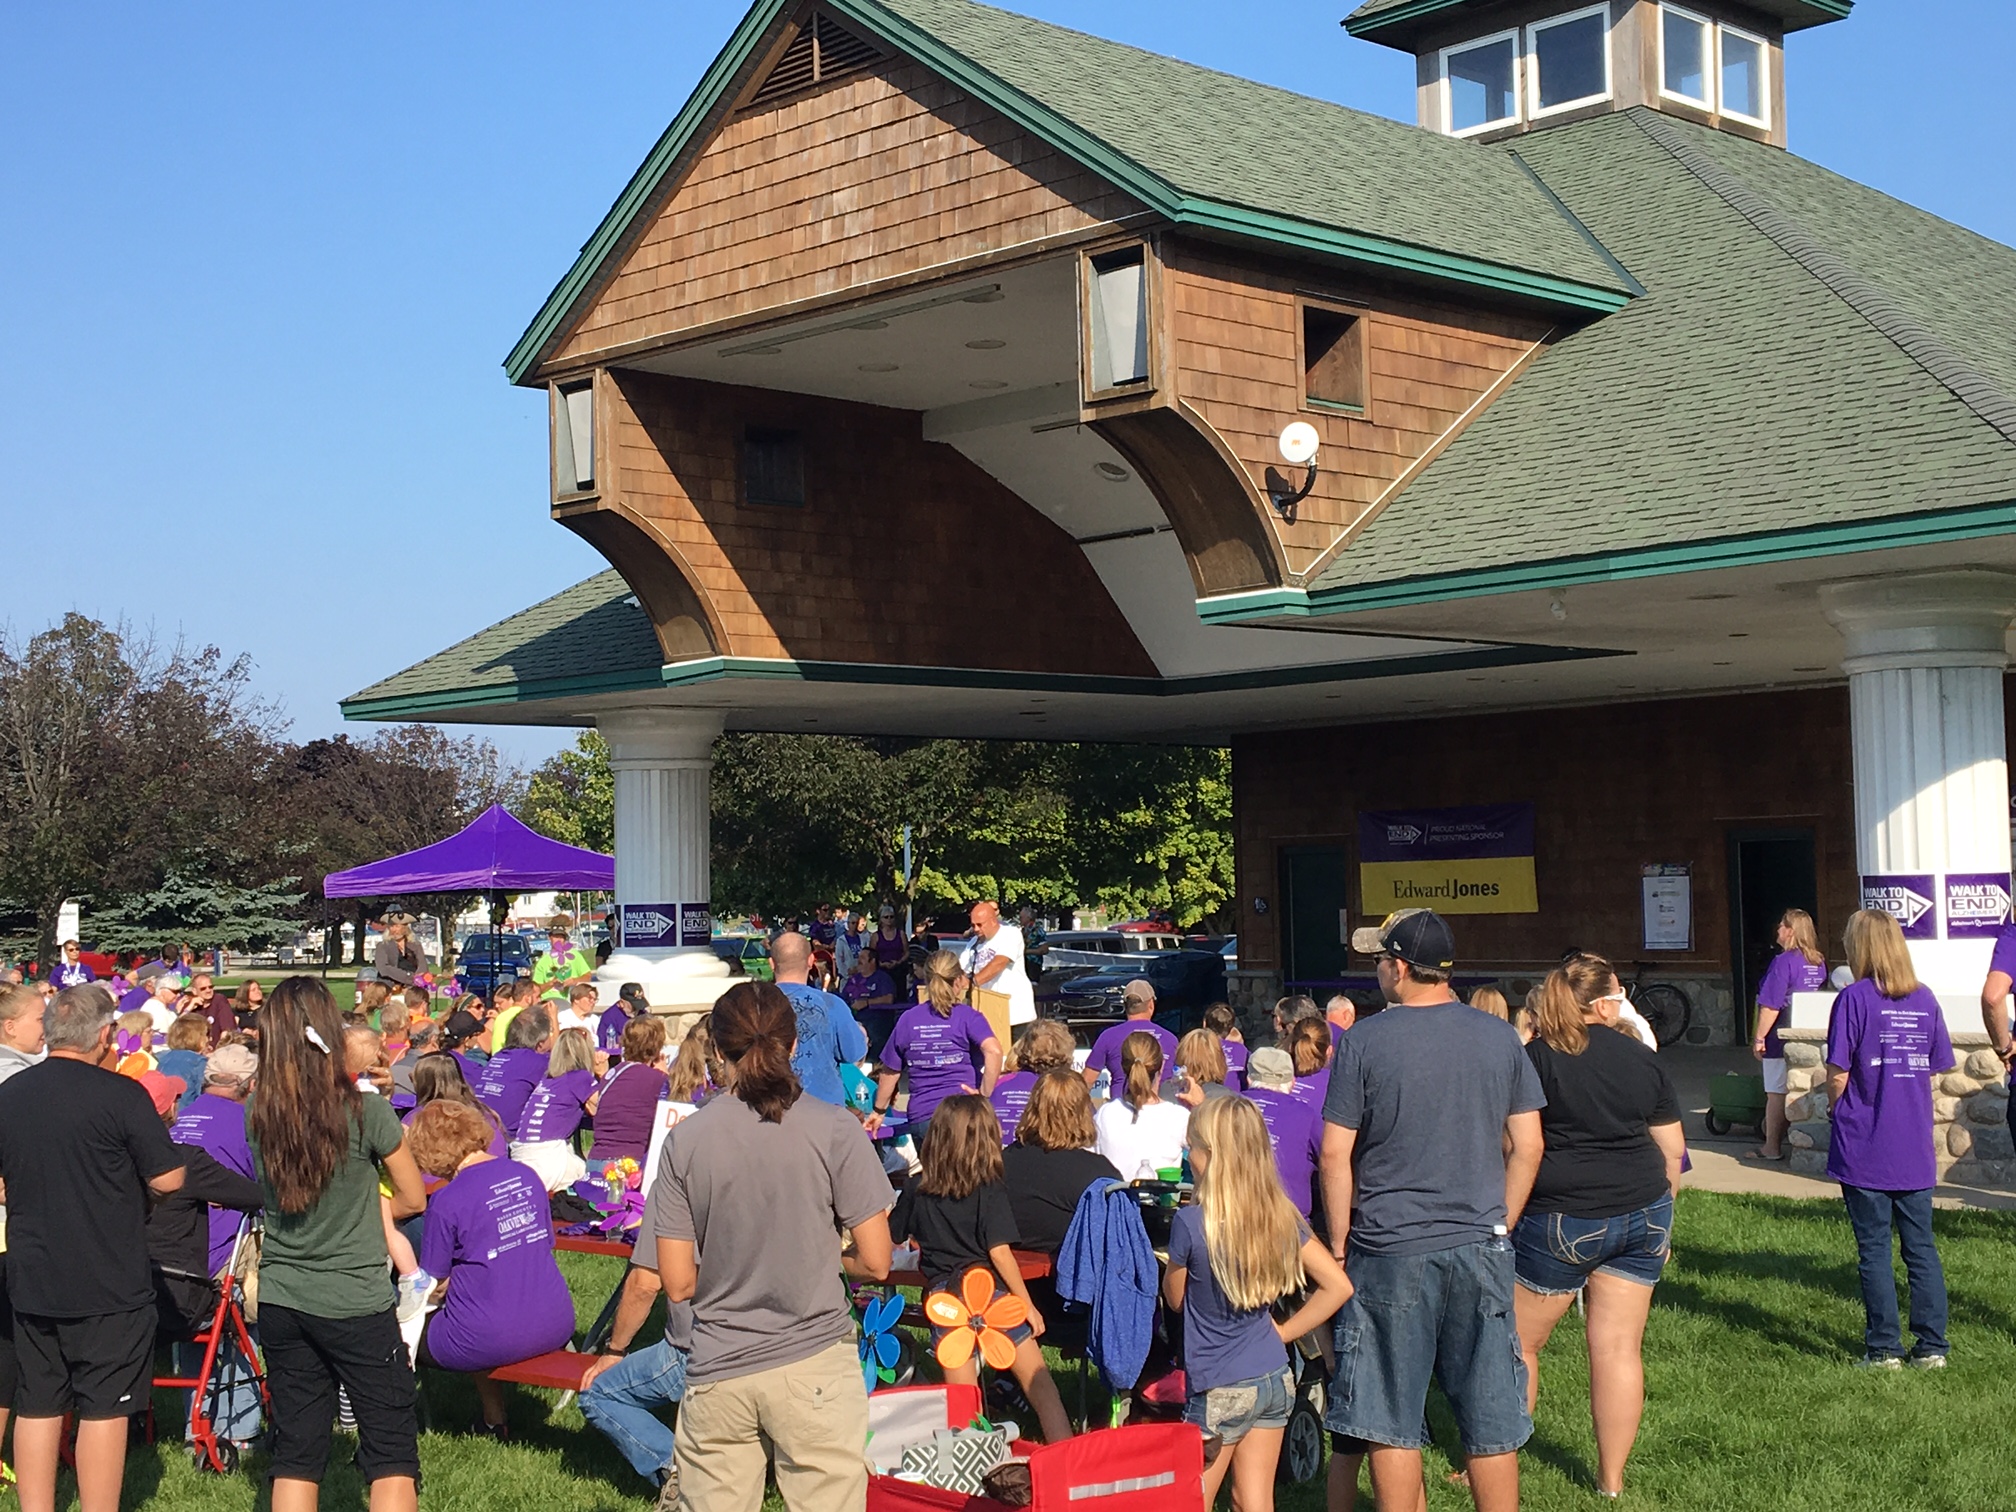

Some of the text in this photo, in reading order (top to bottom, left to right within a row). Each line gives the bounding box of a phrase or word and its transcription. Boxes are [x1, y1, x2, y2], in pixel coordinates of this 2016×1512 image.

[1431, 824, 1487, 833] PROUD NATIONAL
[1429, 831, 1505, 842] PRESENTING SPONSOR
[1864, 886, 1903, 898] WALK TO
[1949, 884, 1997, 896] WALK TO
[1865, 900, 1904, 911] END
[1951, 898, 1997, 910] END
[625, 911, 656, 919] WALK TO
[626, 920, 656, 929] END
[684, 919, 708, 928] END
